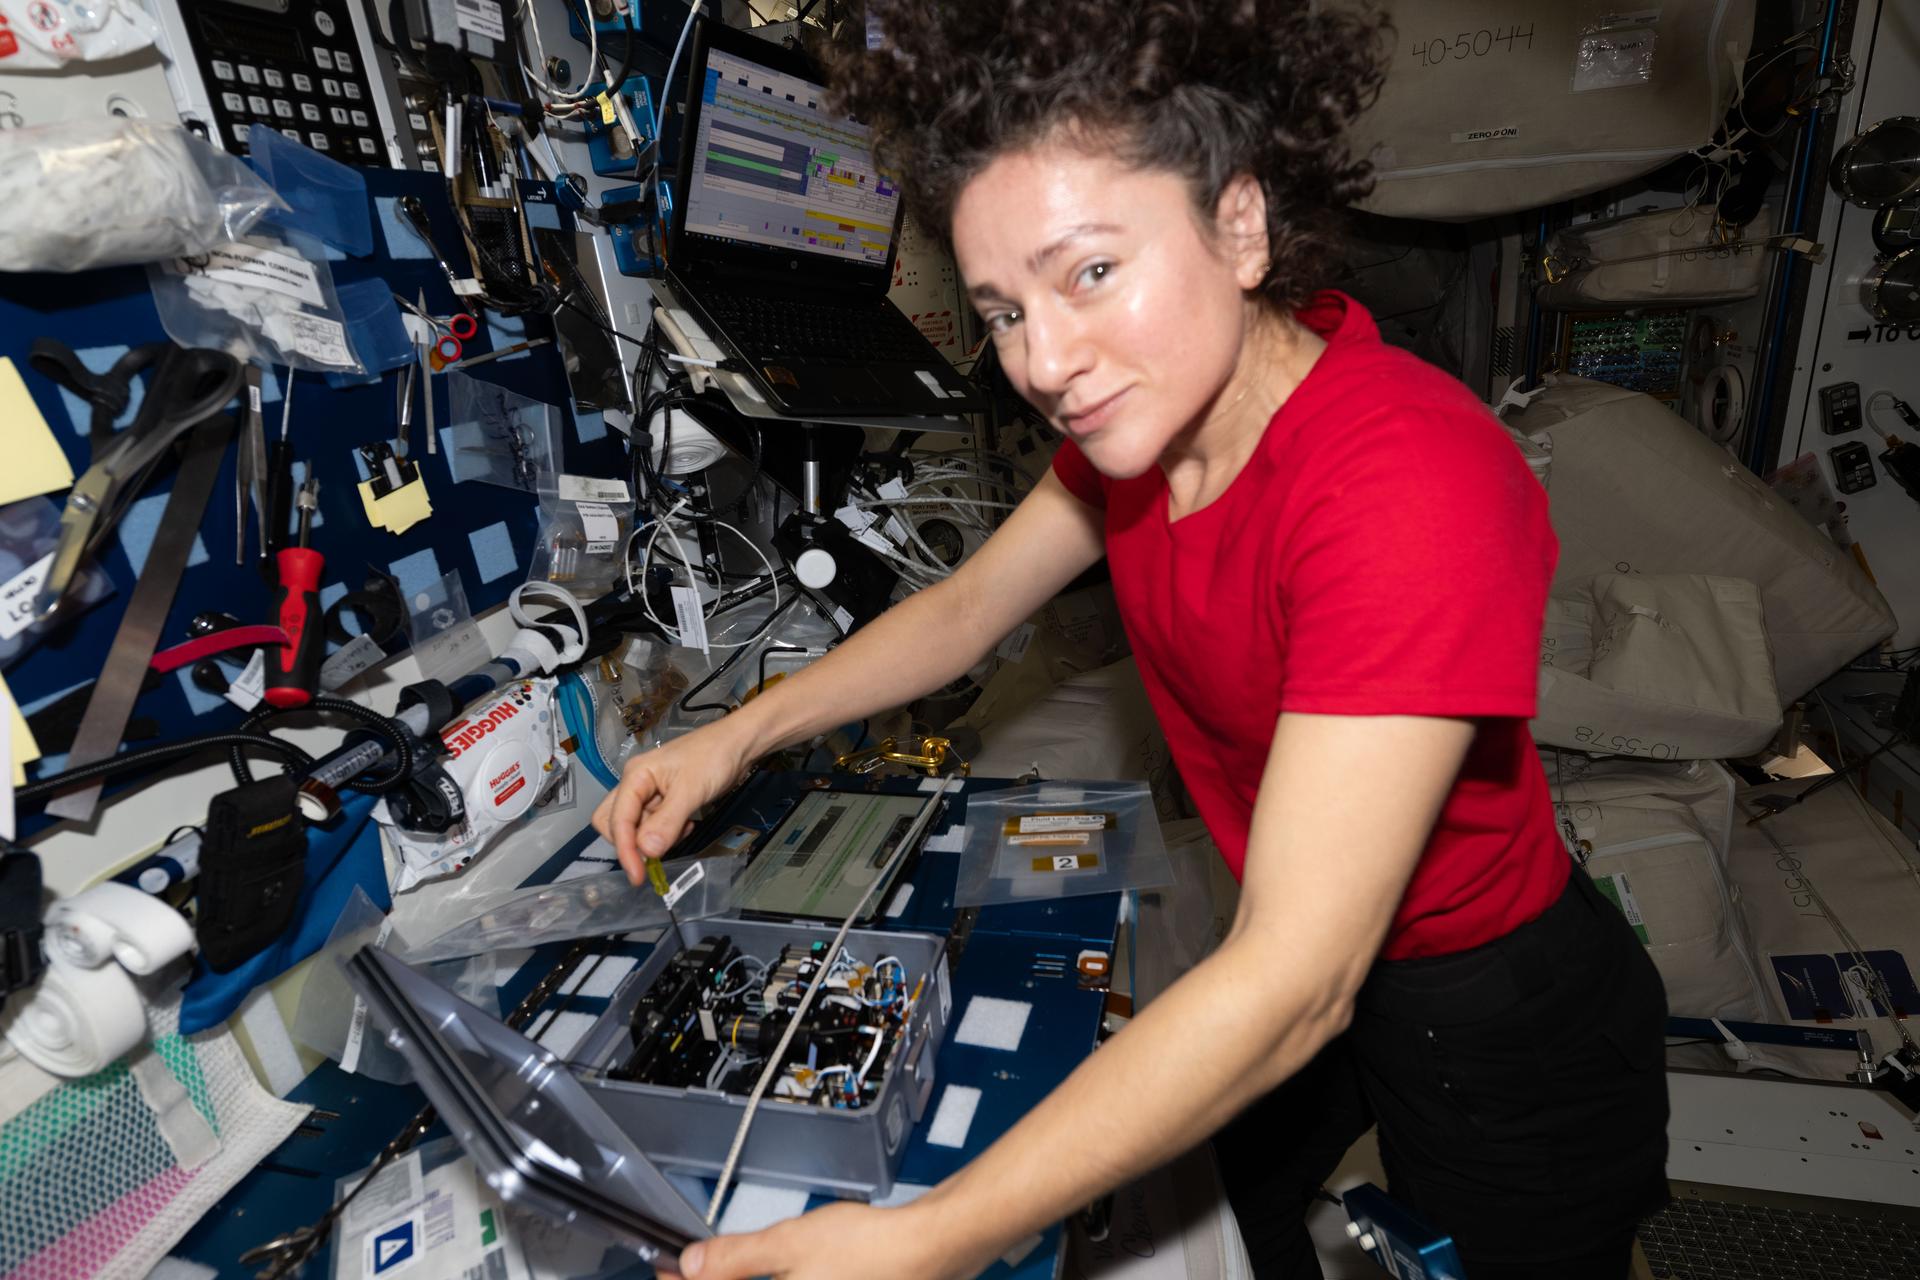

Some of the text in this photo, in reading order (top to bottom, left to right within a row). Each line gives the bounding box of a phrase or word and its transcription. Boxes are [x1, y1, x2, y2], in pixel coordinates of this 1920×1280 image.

[1467, 130, 1493, 141] ZERO
[1874, 324, 1900, 343] To
[445, 700, 519, 762] HUGGIES
[488, 761, 521, 789] HUGGIES
[439, 777, 462, 818] PETZL
[1058, 857, 1073, 869] 2
